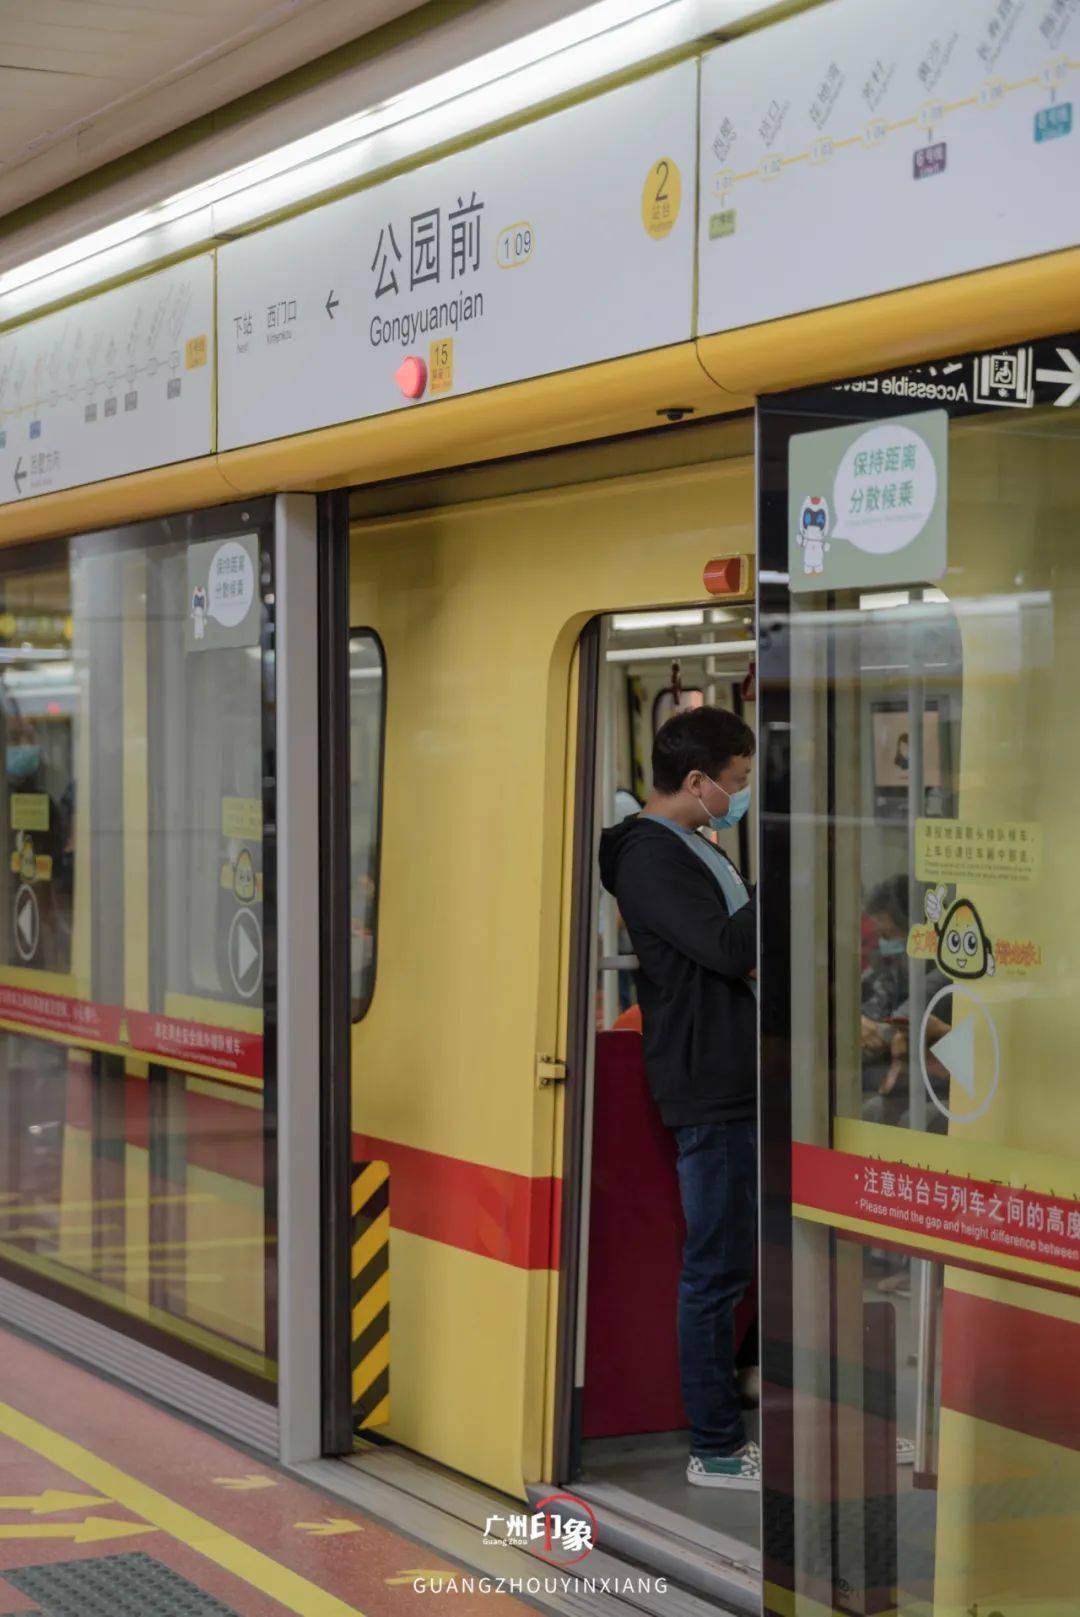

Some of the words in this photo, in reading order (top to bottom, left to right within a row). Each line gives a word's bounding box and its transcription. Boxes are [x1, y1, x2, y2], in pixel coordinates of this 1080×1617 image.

[655, 160, 670, 202] 2
[371, 190, 485, 300] 公园前
[233, 311, 252, 339] 下站
[267, 299, 297, 329] 西门口
[369, 290, 484, 347] Gongyuanqian
[435, 343, 448, 367] 15
[854, 444, 917, 478] 保持距离
[848, 481, 914, 514] 分散候乘
[863, 1165, 1080, 1240] 注意站台与列车之间的高度
[860, 1198, 888, 1217] Please
[889, 1206, 909, 1221] mind
[911, 1209, 925, 1225] the
[926, 1215, 942, 1231] gap
[943, 1219, 960, 1233] and
[961, 1220, 990, 1240] height
[991, 1227, 1037, 1251] difference
[1038, 1240, 1080, 1261] between
